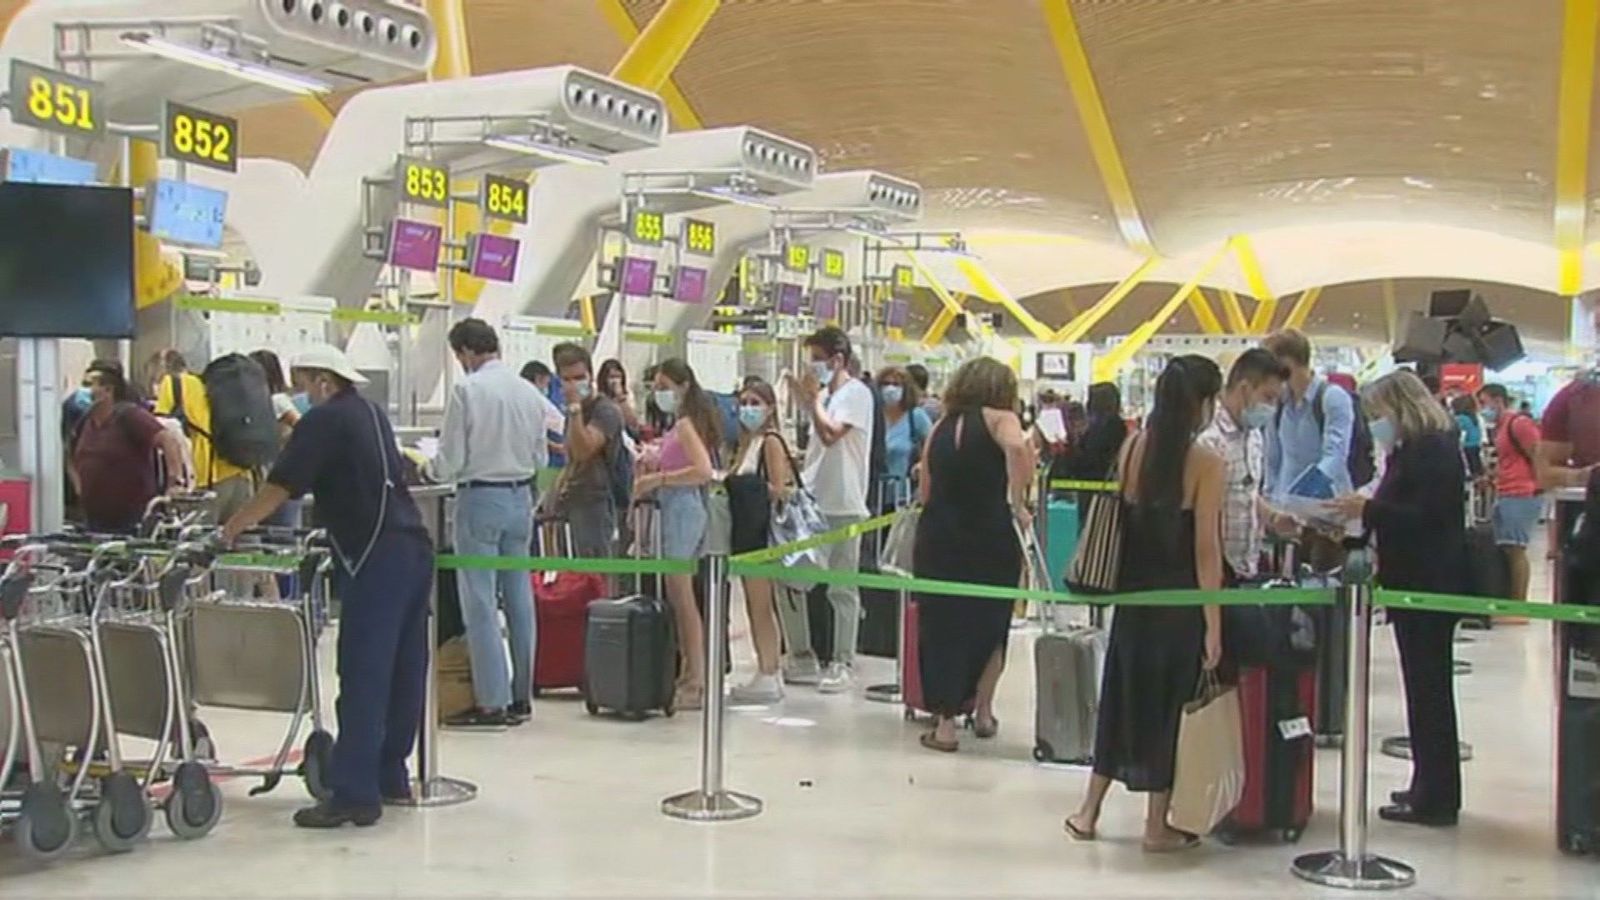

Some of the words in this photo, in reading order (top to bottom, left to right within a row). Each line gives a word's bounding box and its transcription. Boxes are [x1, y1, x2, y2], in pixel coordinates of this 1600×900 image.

[28, 76, 94, 128] 851
[174, 115, 229, 162] 852
[406, 165, 446, 201] 853
[489, 184, 525, 217] 854
[635, 212, 661, 241] 855
